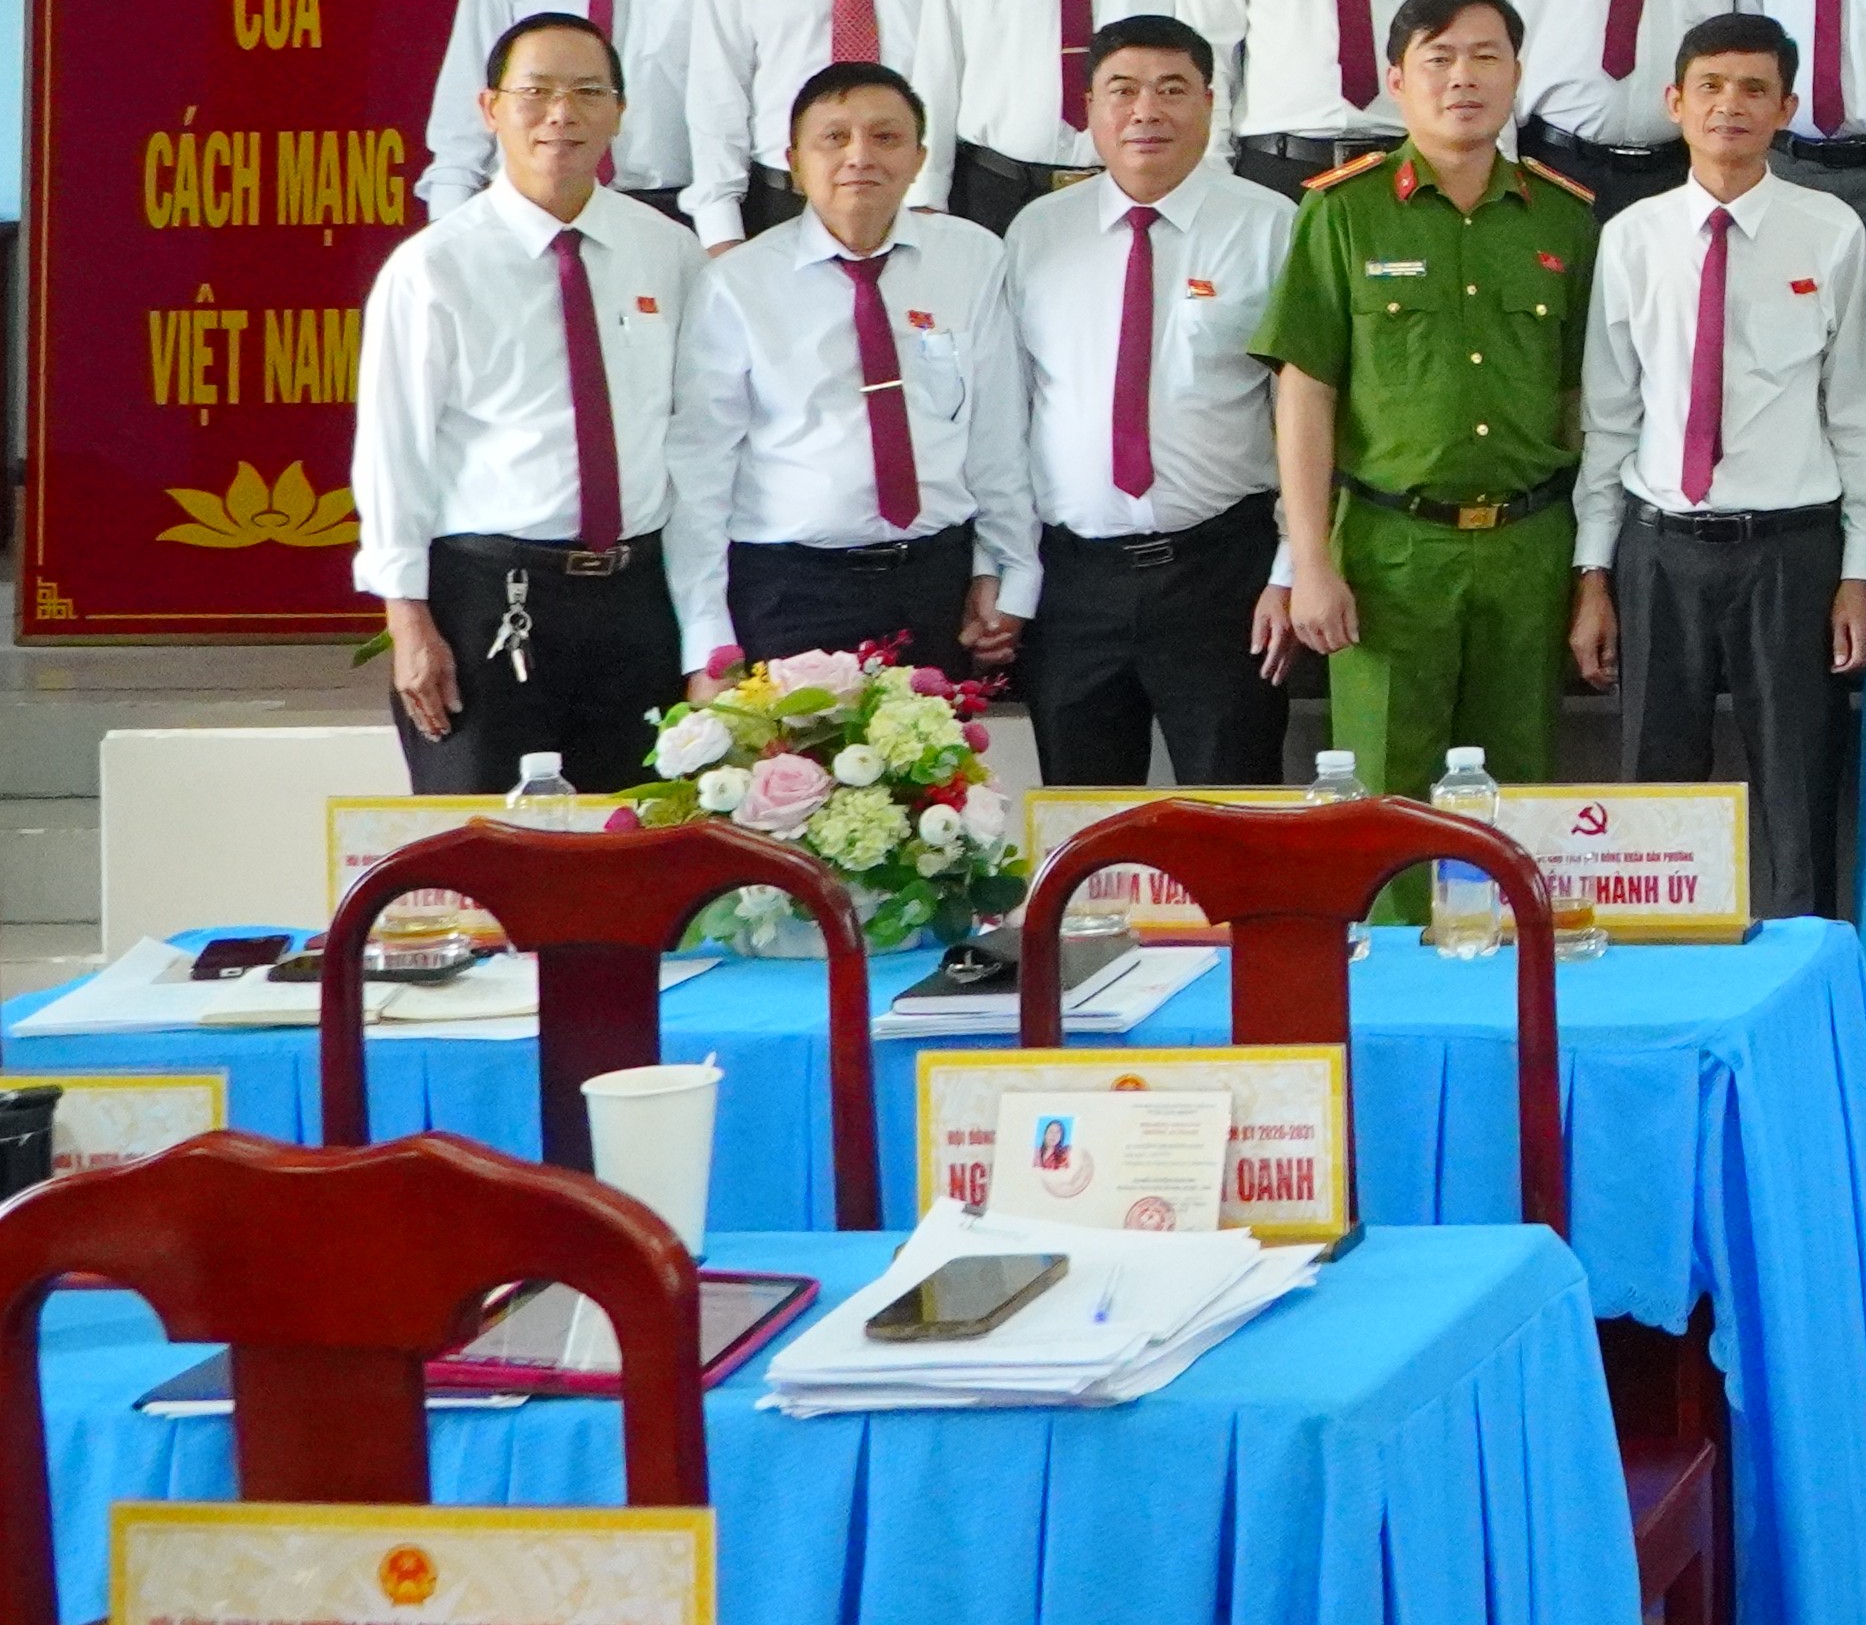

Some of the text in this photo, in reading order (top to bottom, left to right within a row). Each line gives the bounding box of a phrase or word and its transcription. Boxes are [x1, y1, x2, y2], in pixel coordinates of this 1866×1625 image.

[145, 109, 404, 241] CÁCH MẠNG
[150, 286, 359, 423] VIỆT NAM
[1237, 1158, 1315, 1202] OANH
